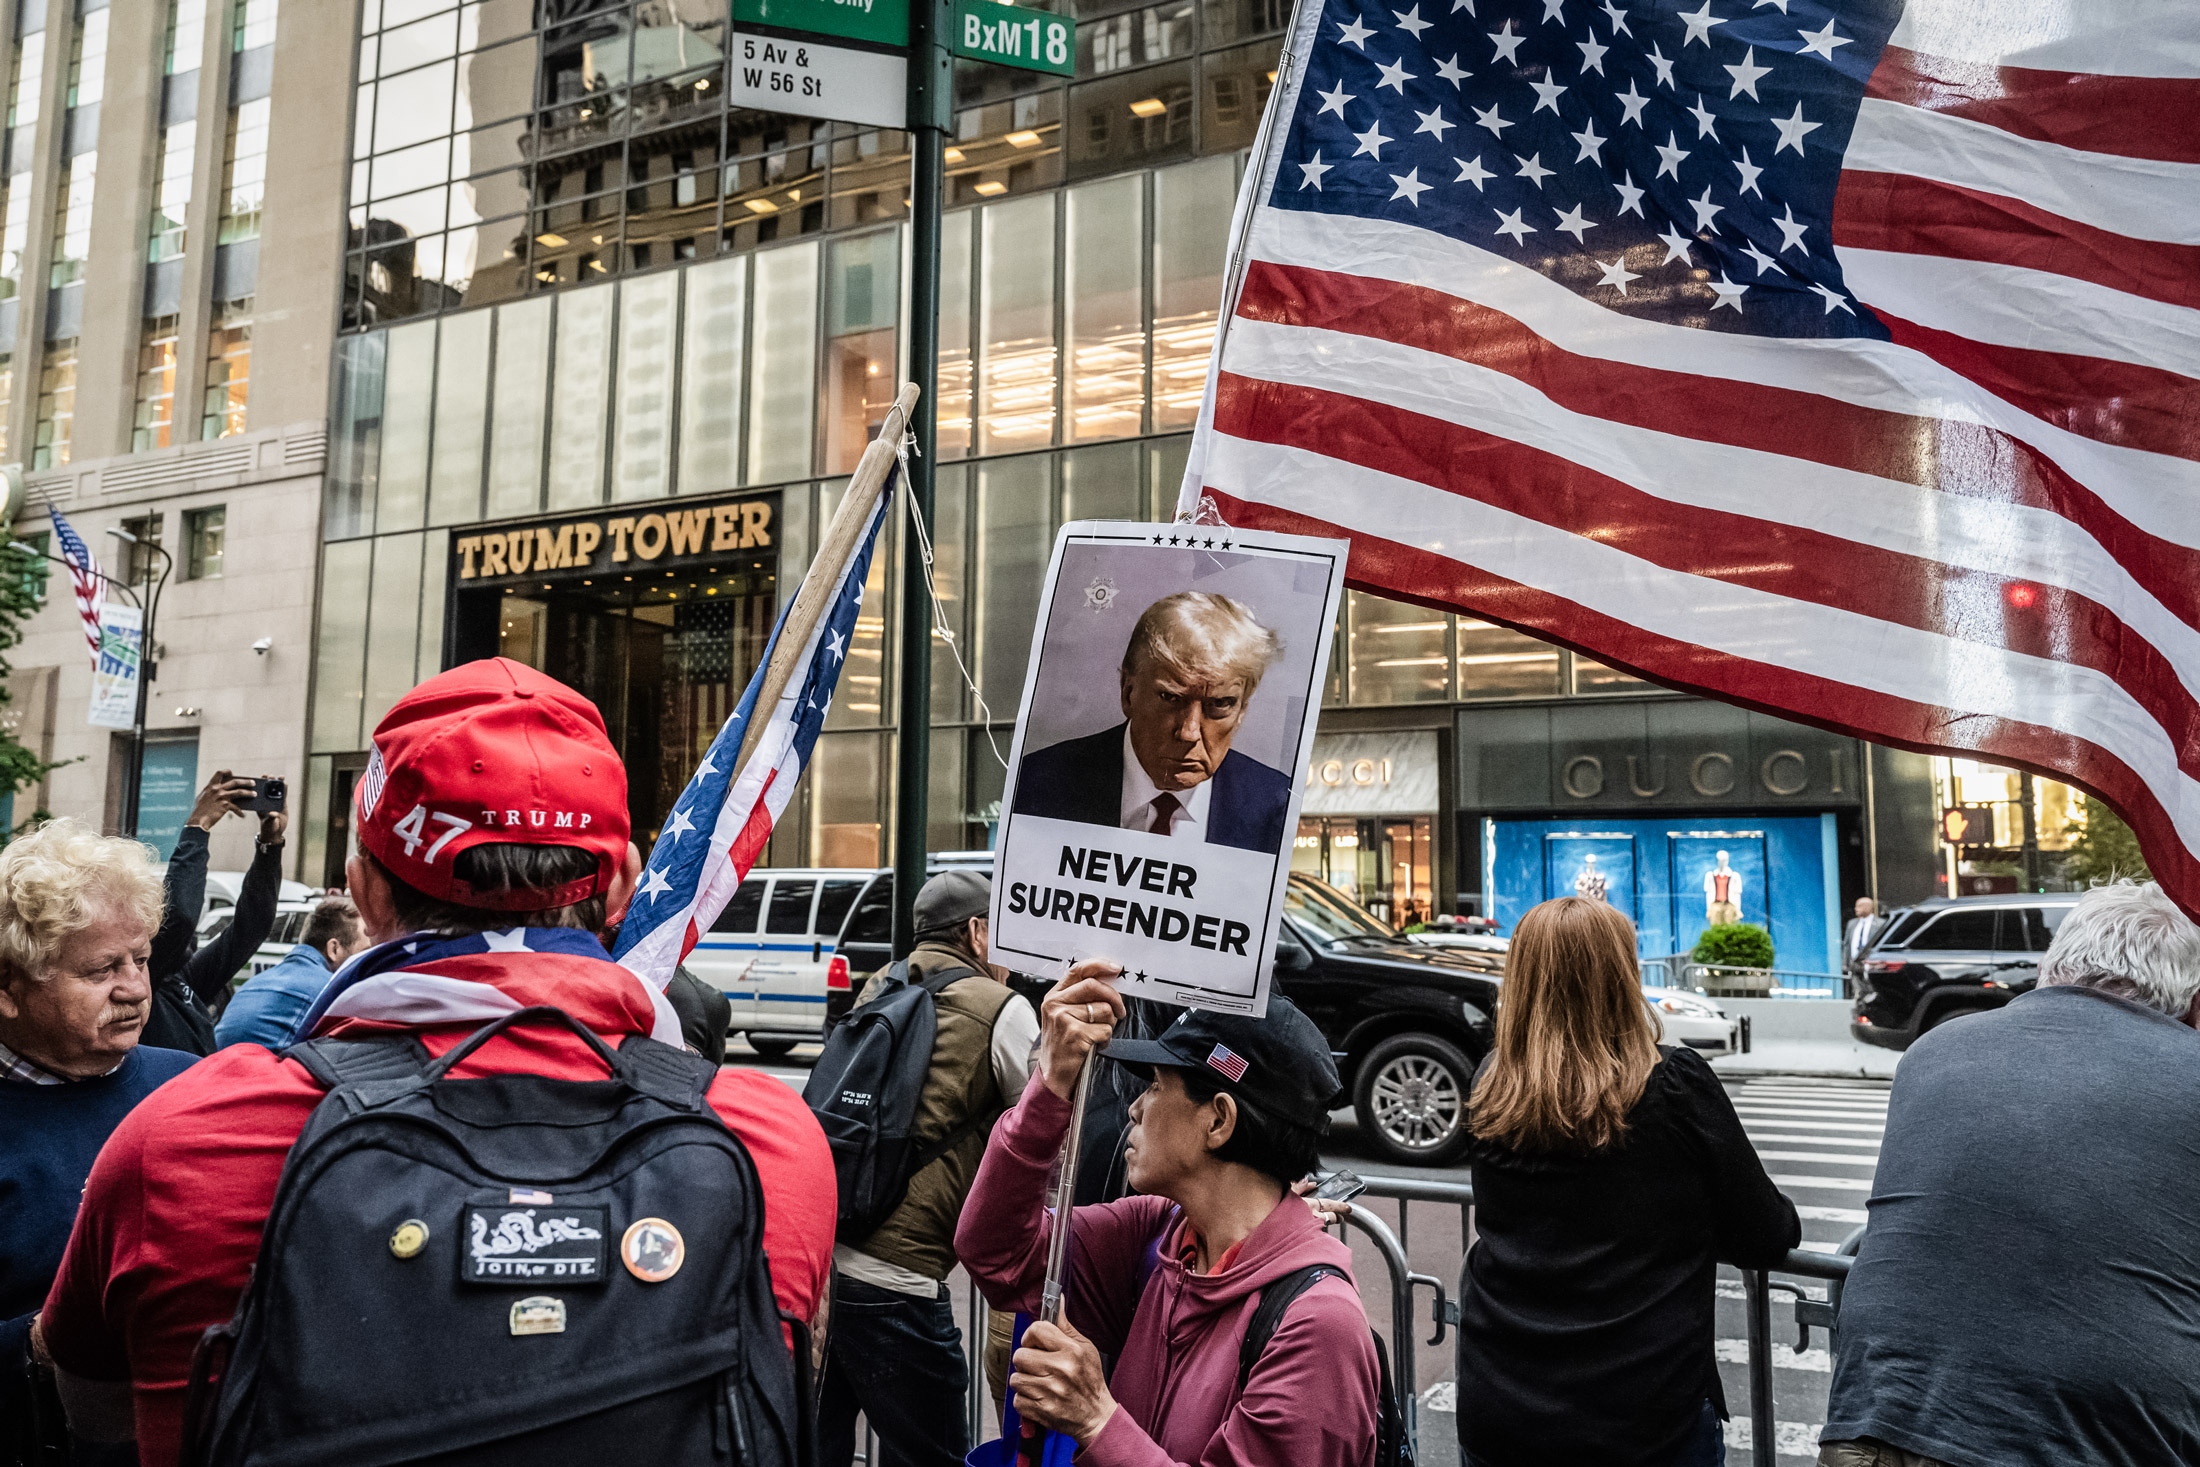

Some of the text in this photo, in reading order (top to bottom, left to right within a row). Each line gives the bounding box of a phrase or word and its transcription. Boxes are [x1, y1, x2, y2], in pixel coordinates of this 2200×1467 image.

[744, 40, 809, 68] 5 Av &
[964, 13, 1067, 65] BxM18
[743, 67, 821, 97] W 56 St
[457, 502, 772, 580] TRUMP TOWER
[1305, 759, 1391, 786] CCI
[1562, 749, 1843, 798] GUCCI
[393, 803, 473, 864] 47
[481, 810, 592, 829] TRUMP
[1058, 845, 1198, 899] NEVER
[1008, 882, 1251, 957] SURRENDER
